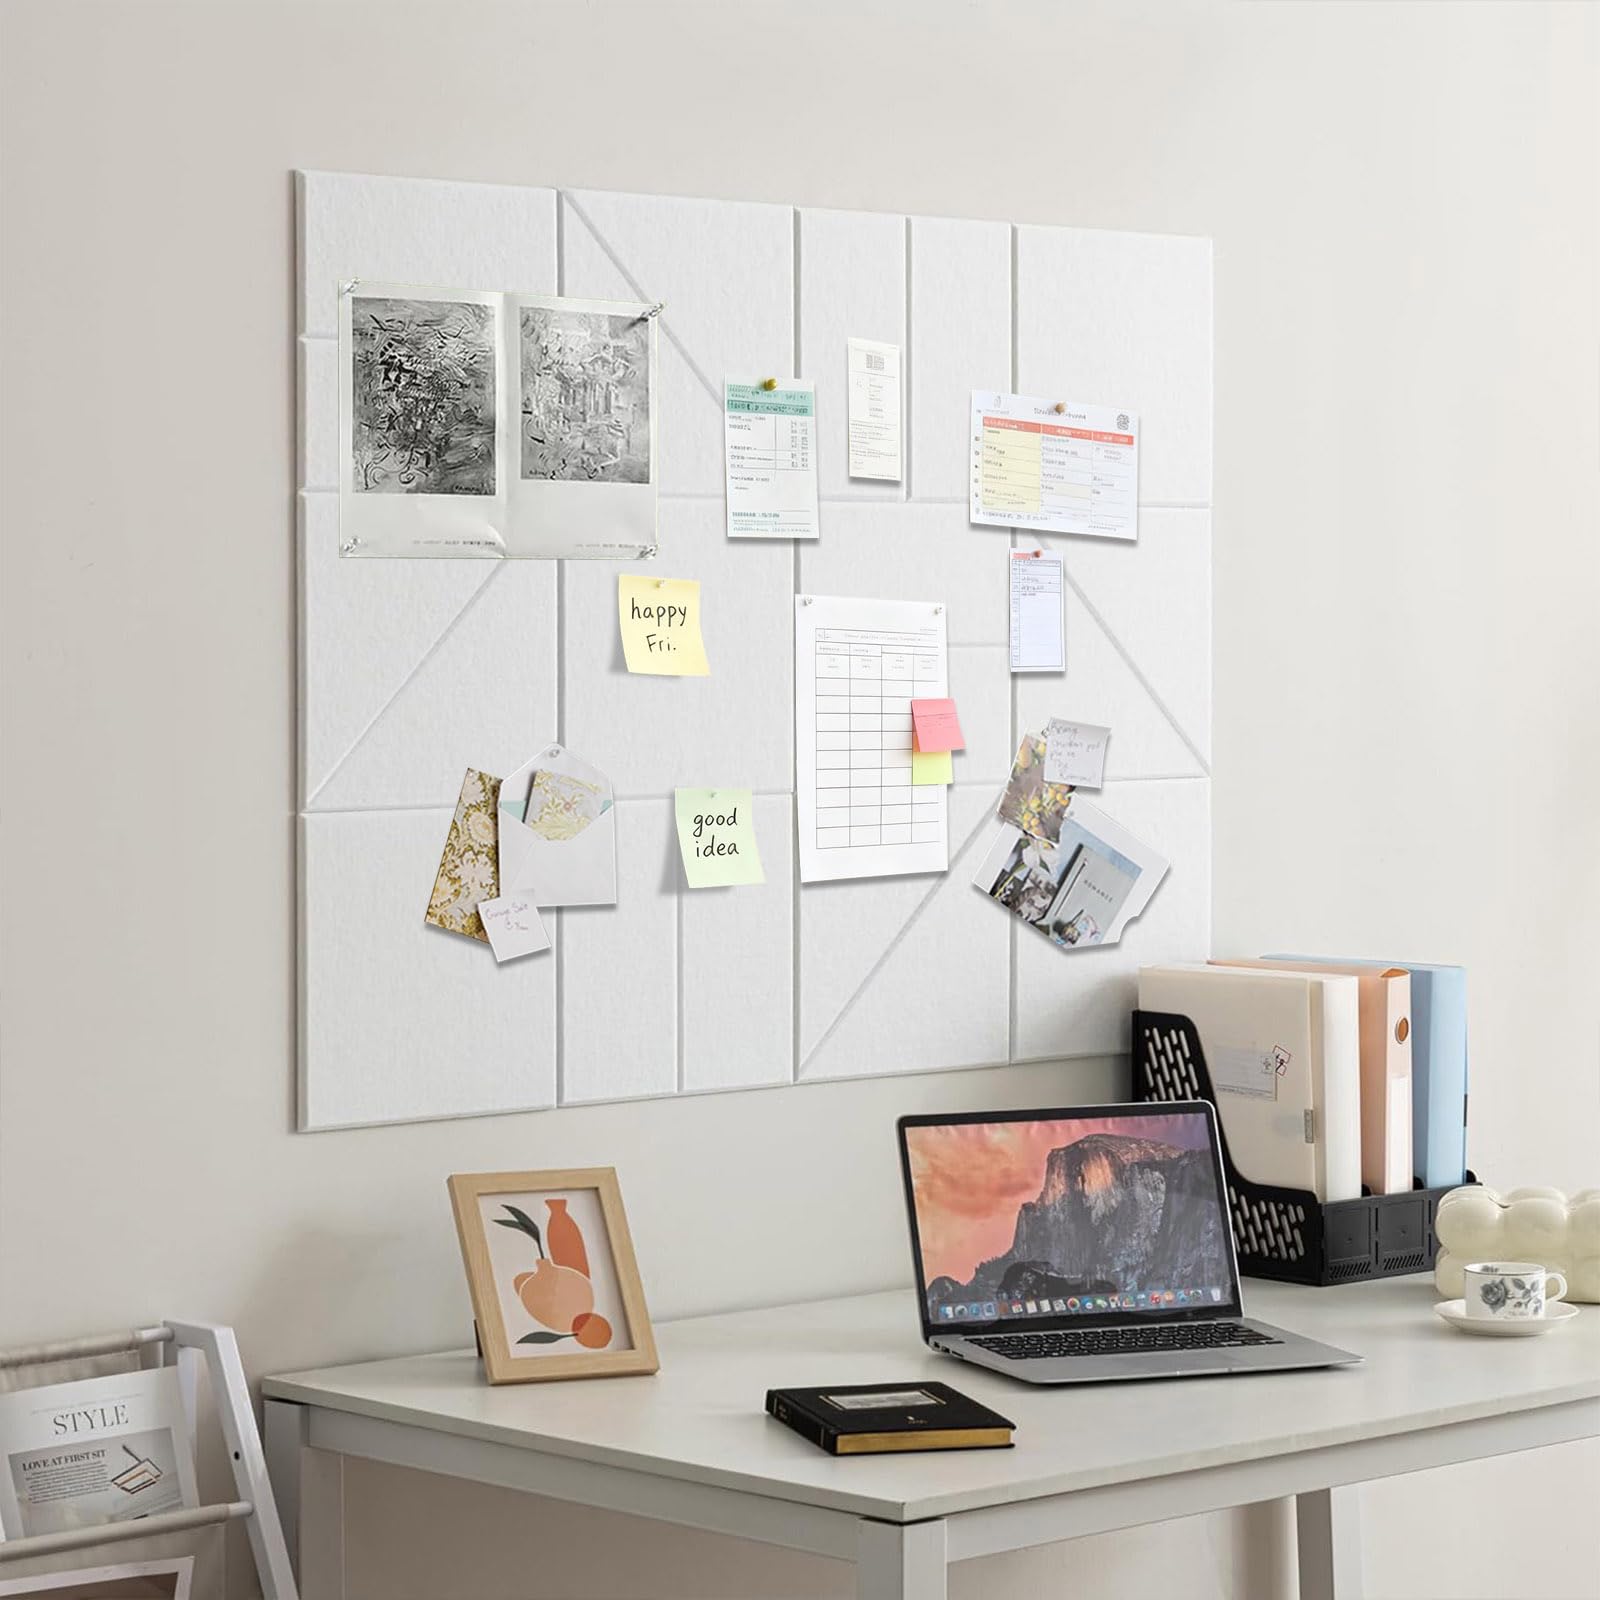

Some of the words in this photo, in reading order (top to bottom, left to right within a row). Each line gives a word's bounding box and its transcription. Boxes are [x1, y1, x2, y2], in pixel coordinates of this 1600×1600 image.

[630, 597, 687, 627] happy
[646, 634, 677, 652] Fri.
[692, 807, 738, 837] good
[695, 835, 740, 858] idea
[53, 1404, 129, 1436] STYLE
[22, 1459, 49, 1471] LOVE
[52, 1456, 63, 1466] AT
[64, 1452, 90, 1464] FIRST
